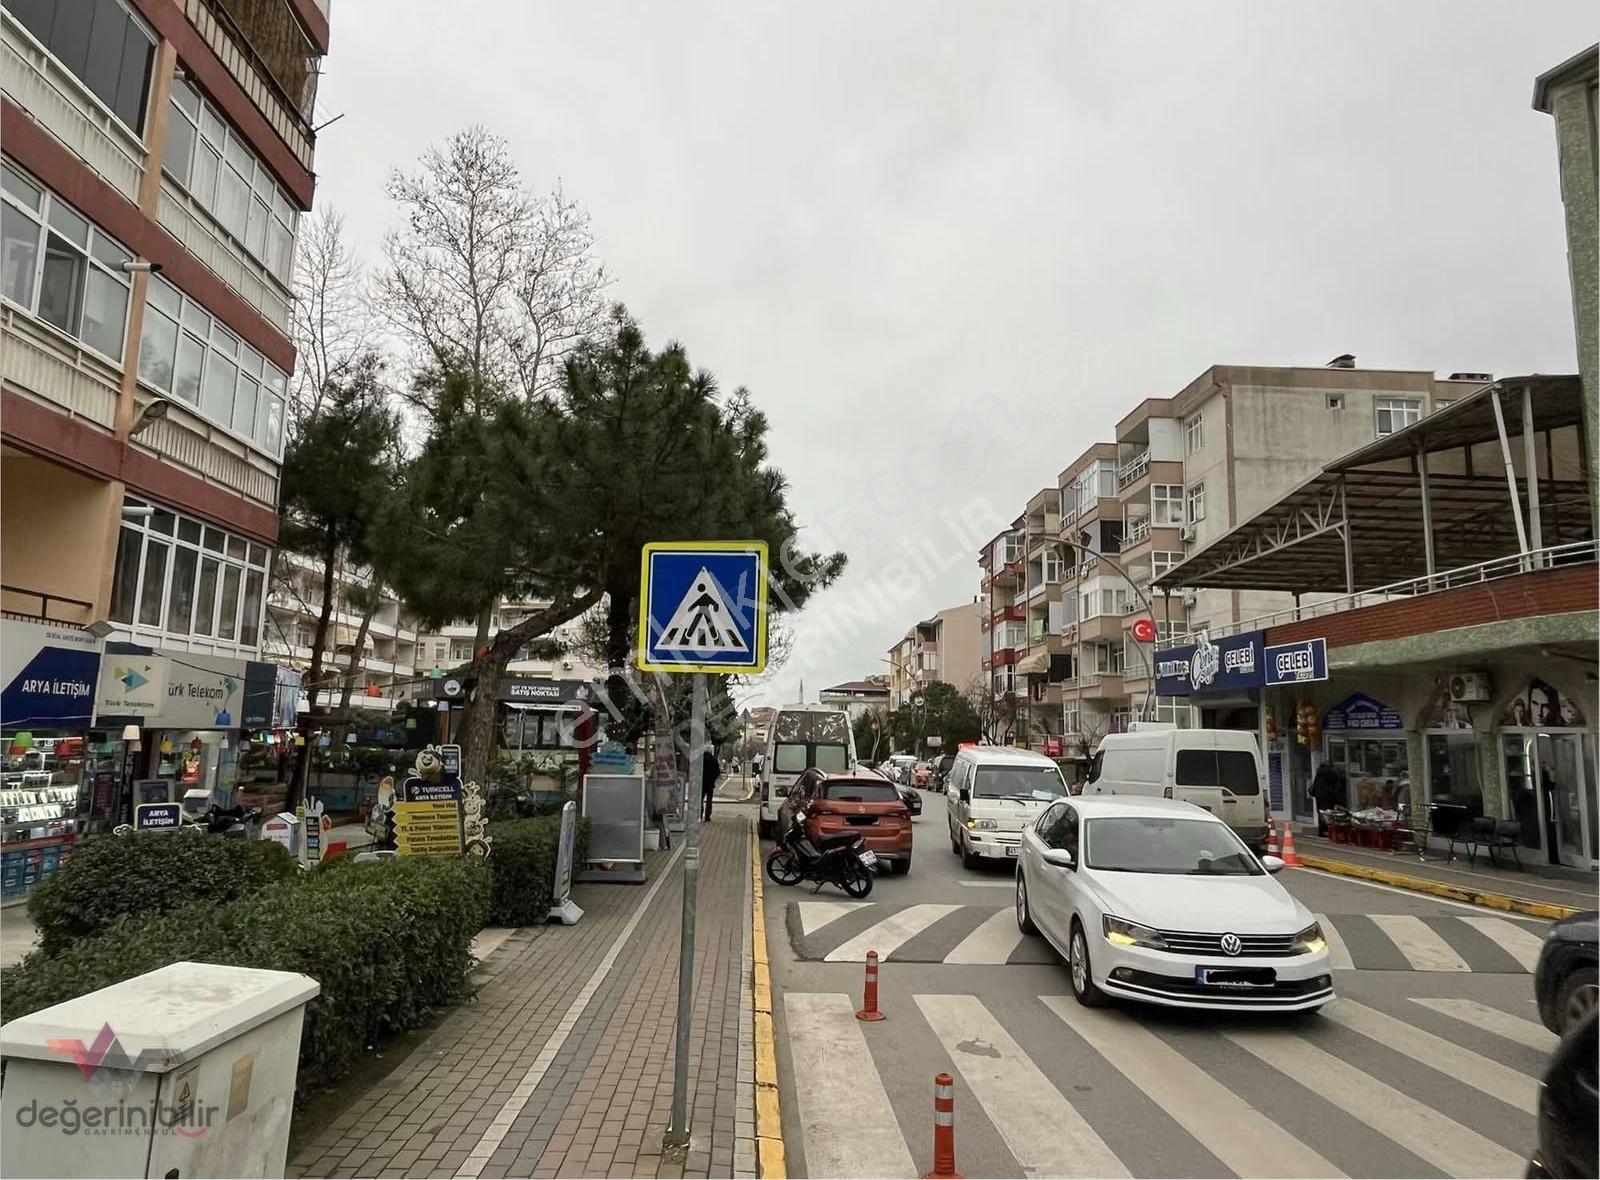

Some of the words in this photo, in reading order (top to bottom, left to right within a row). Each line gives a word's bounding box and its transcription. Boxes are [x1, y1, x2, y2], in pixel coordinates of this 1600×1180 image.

[1224, 641, 1255, 674] ÇELEBİ
[1276, 642, 1314, 680] ÇELEBİ
[22, 679, 50, 694] ARYA
[52, 678, 90, 699] İLETİŞİM
[168, 682, 184, 696] ürk
[187, 683, 223, 699] Telekom
